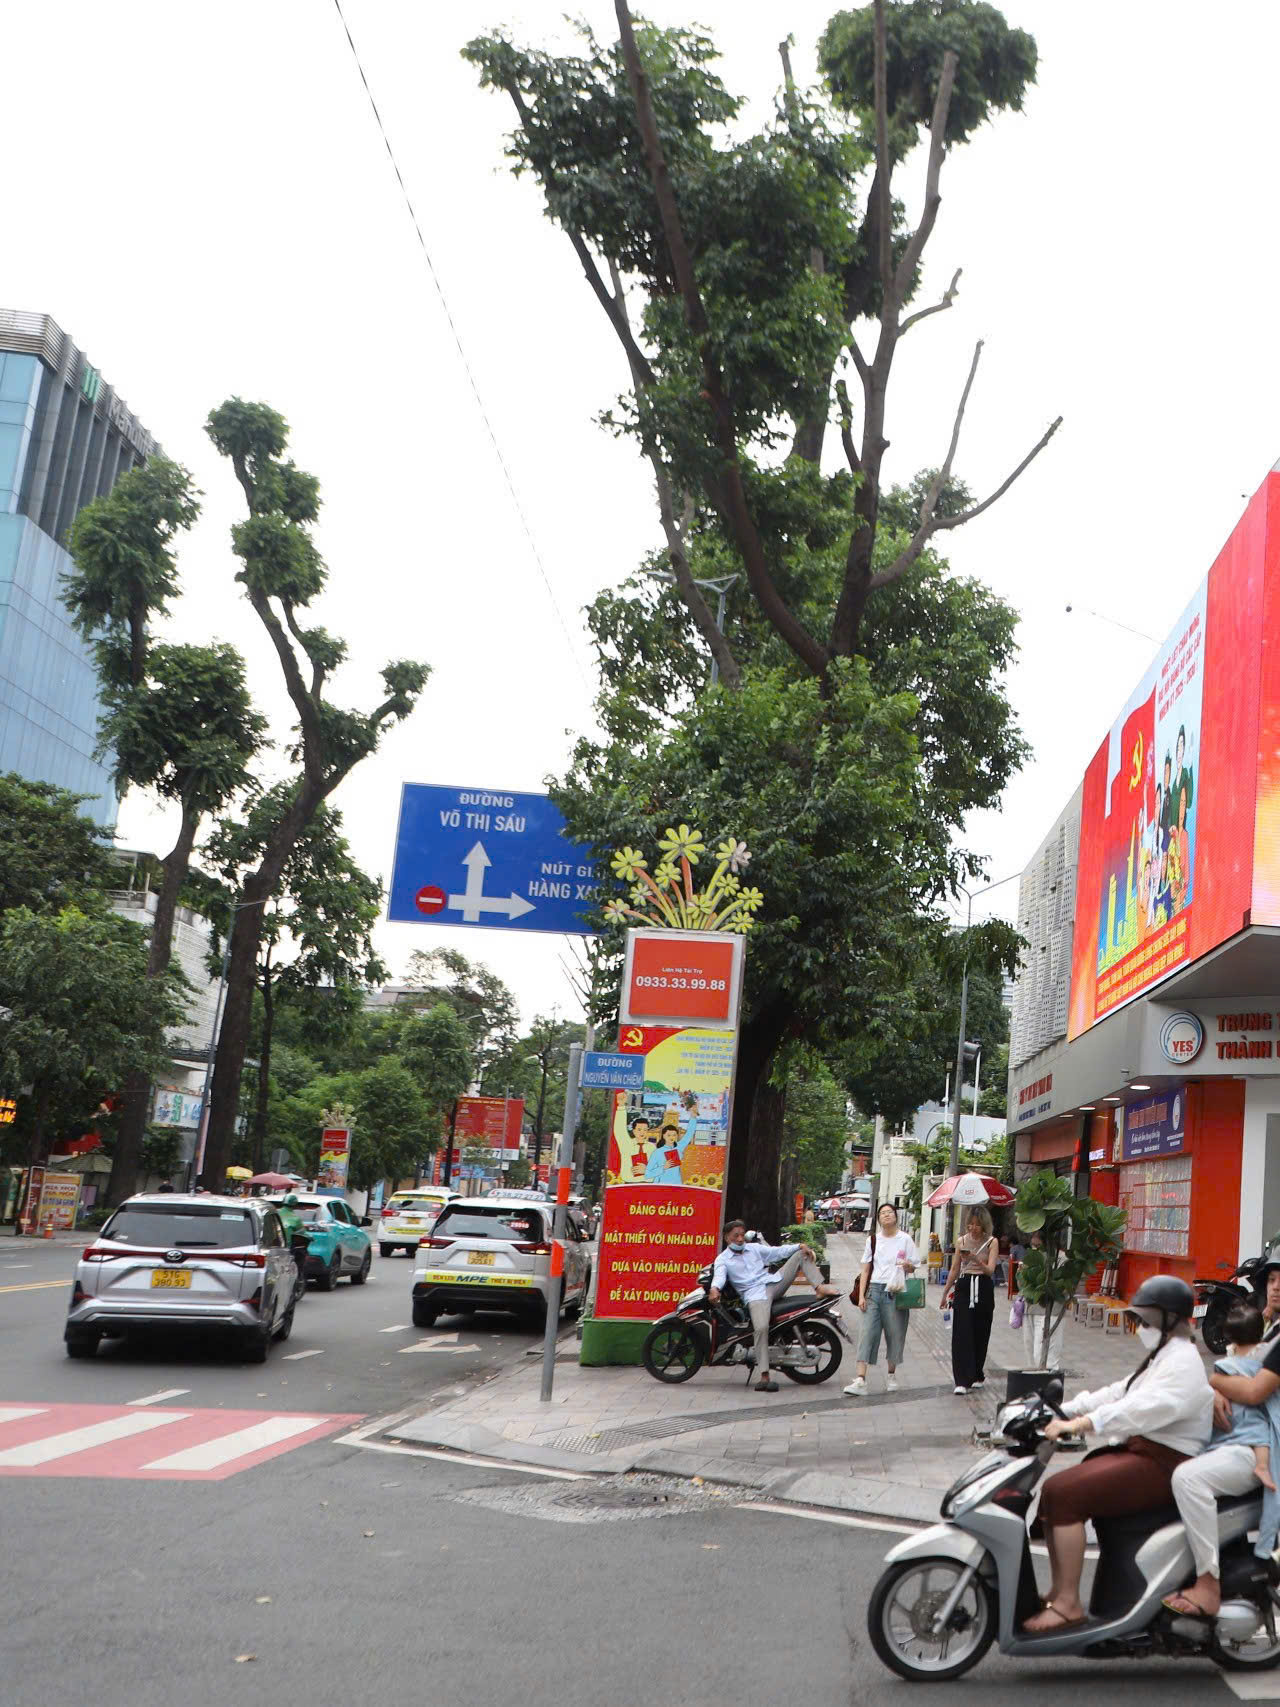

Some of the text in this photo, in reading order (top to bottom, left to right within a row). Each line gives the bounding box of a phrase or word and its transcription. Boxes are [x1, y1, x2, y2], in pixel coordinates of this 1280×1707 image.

[460, 792, 514, 808] ĐƯỜNG
[440, 810, 526, 832] VÕ THỊ SÁU
[541, 861, 573, 876] NÚT
[528, 877, 571, 899] HÀNG
[636, 976, 726, 991] 0933.33.99.88
[1216, 1012, 1272, 1032] TRUNG
[1172, 1040, 1194, 1052] YES
[1216, 1035, 1272, 1059] THÀNH
[598, 1056, 632, 1068] ĐƯỜNG
[586, 1069, 609, 1083] NGUYỄN
[629, 1201, 695, 1216] ĐẢNG GẮN BÓ
[604, 1230, 715, 1246] MẬT THIẾT VỚI NHÂN DÂN
[611, 1260, 702, 1275] DỰA VÀO NHÂN DÂN
[456, 1275, 489, 1283] MPE
[610, 1286, 688, 1304] ĐỂ XÂY DỰNG ĐẢ
